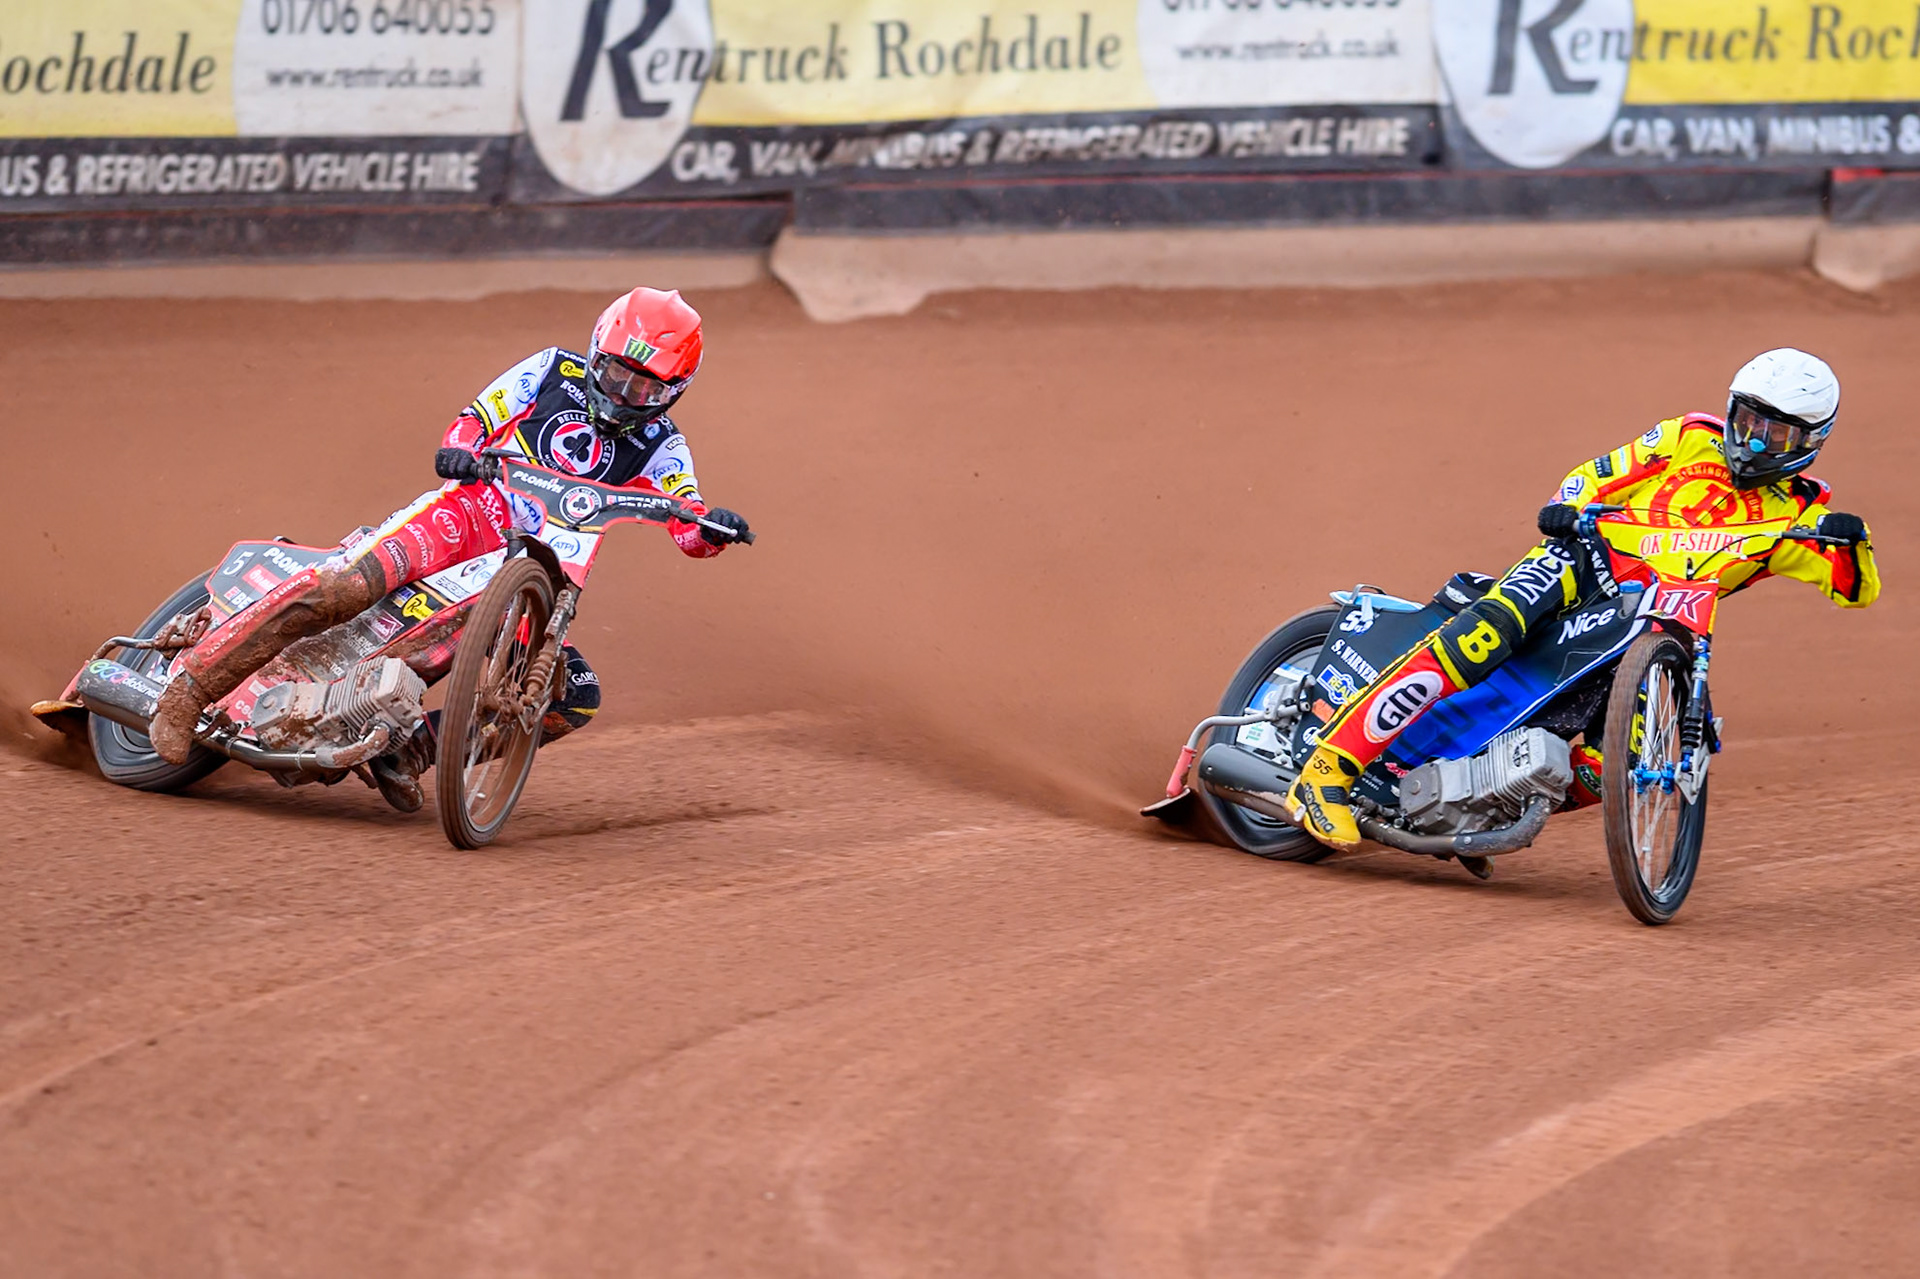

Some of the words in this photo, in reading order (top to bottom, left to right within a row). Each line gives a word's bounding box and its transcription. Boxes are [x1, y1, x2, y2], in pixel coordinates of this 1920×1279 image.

[0, 30, 217, 95] ochdale
[873, 12, 1122, 80] Rochdale
[1336, 116, 1410, 156] HIRE
[1611, 117, 1678, 161] CAR,
[1685, 116, 1759, 161] VAN,
[1766, 114, 1893, 155] MINIBUS
[44, 154, 70, 195] &
[75, 153, 287, 194] REFRIGERATED
[293, 152, 409, 192] VEHICLE
[410, 152, 480, 192] HIRE
[556, 413, 588, 425] BELLE
[1675, 465, 1734, 482] BIRMINGH
[222, 550, 256, 576] 5
[262, 546, 308, 578] PLOM
[553, 541, 576, 552] ATPI
[1639, 534, 1662, 557] OK
[1671, 531, 1747, 554] T-SHIRT
[1590, 550, 1623, 600] WAR
[1456, 619, 1502, 664] B
[1556, 607, 1617, 646] Nice
[1330, 638, 1346, 656] S.
[1340, 645, 1380, 686] WARNER
